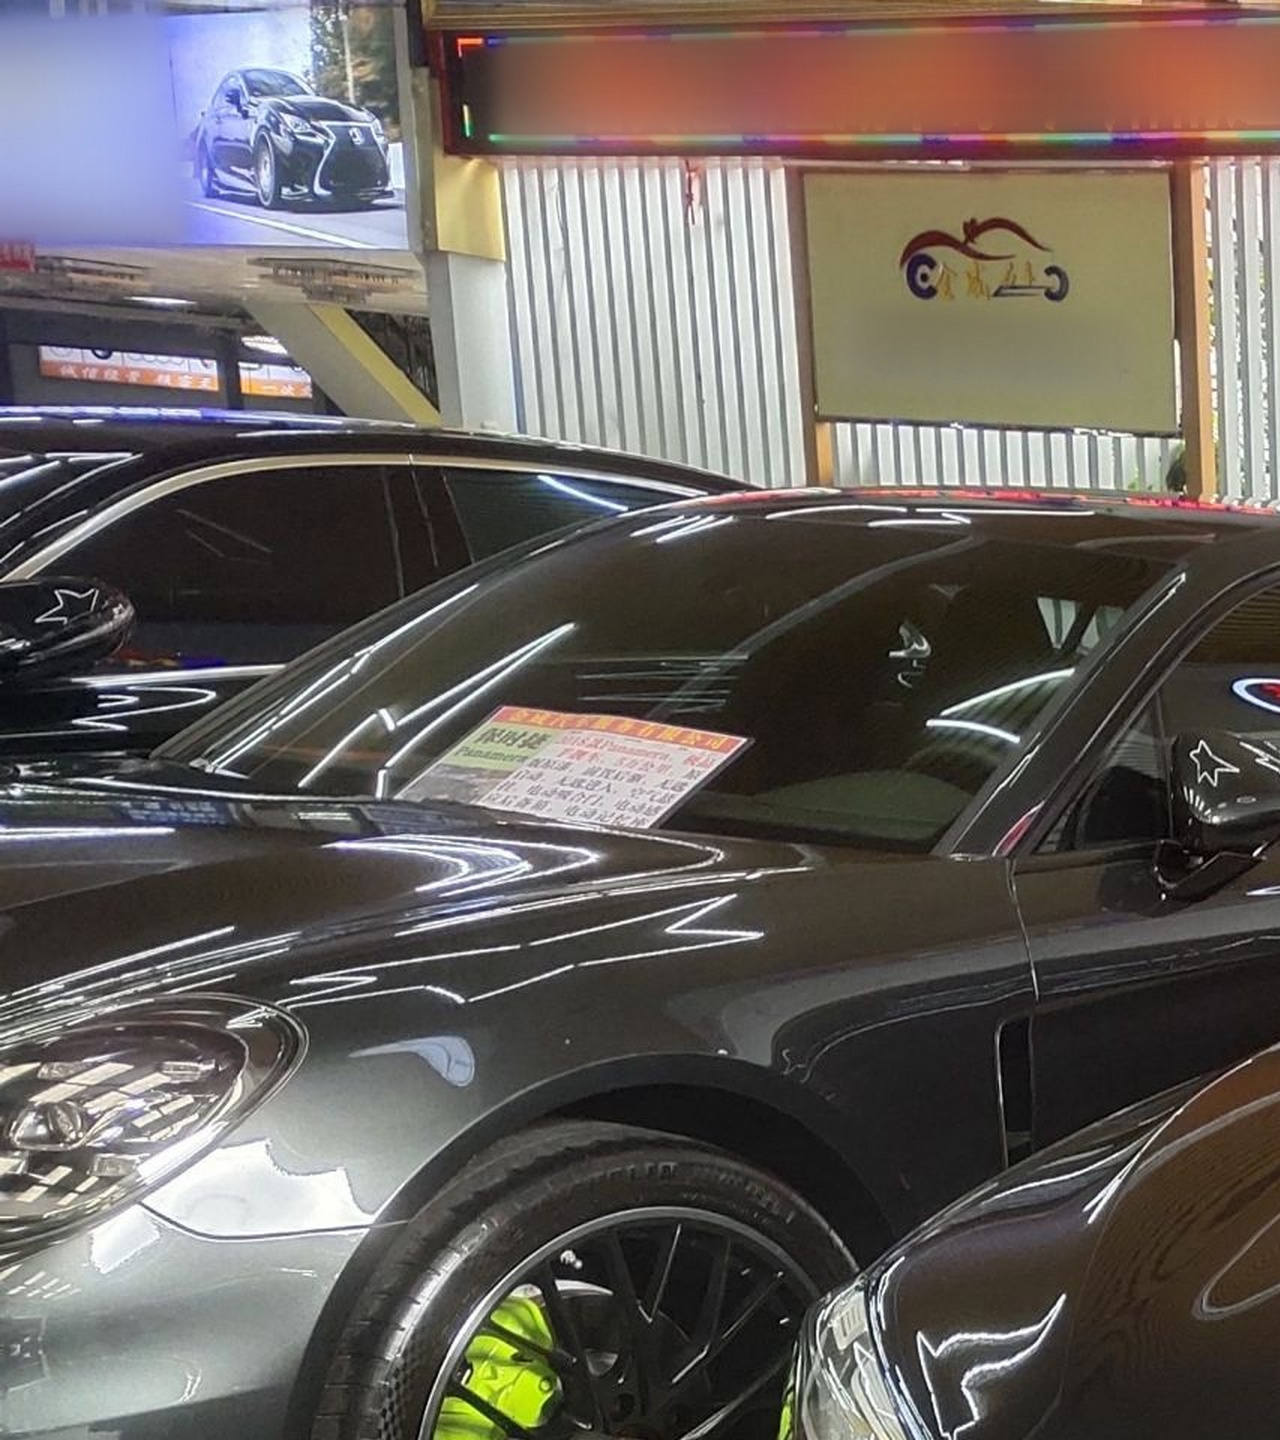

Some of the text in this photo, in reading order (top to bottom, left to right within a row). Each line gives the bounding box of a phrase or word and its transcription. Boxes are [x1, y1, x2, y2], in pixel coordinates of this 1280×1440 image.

[475, 728, 552, 750] 保时捷
[453, 746, 529, 765] Panamera
